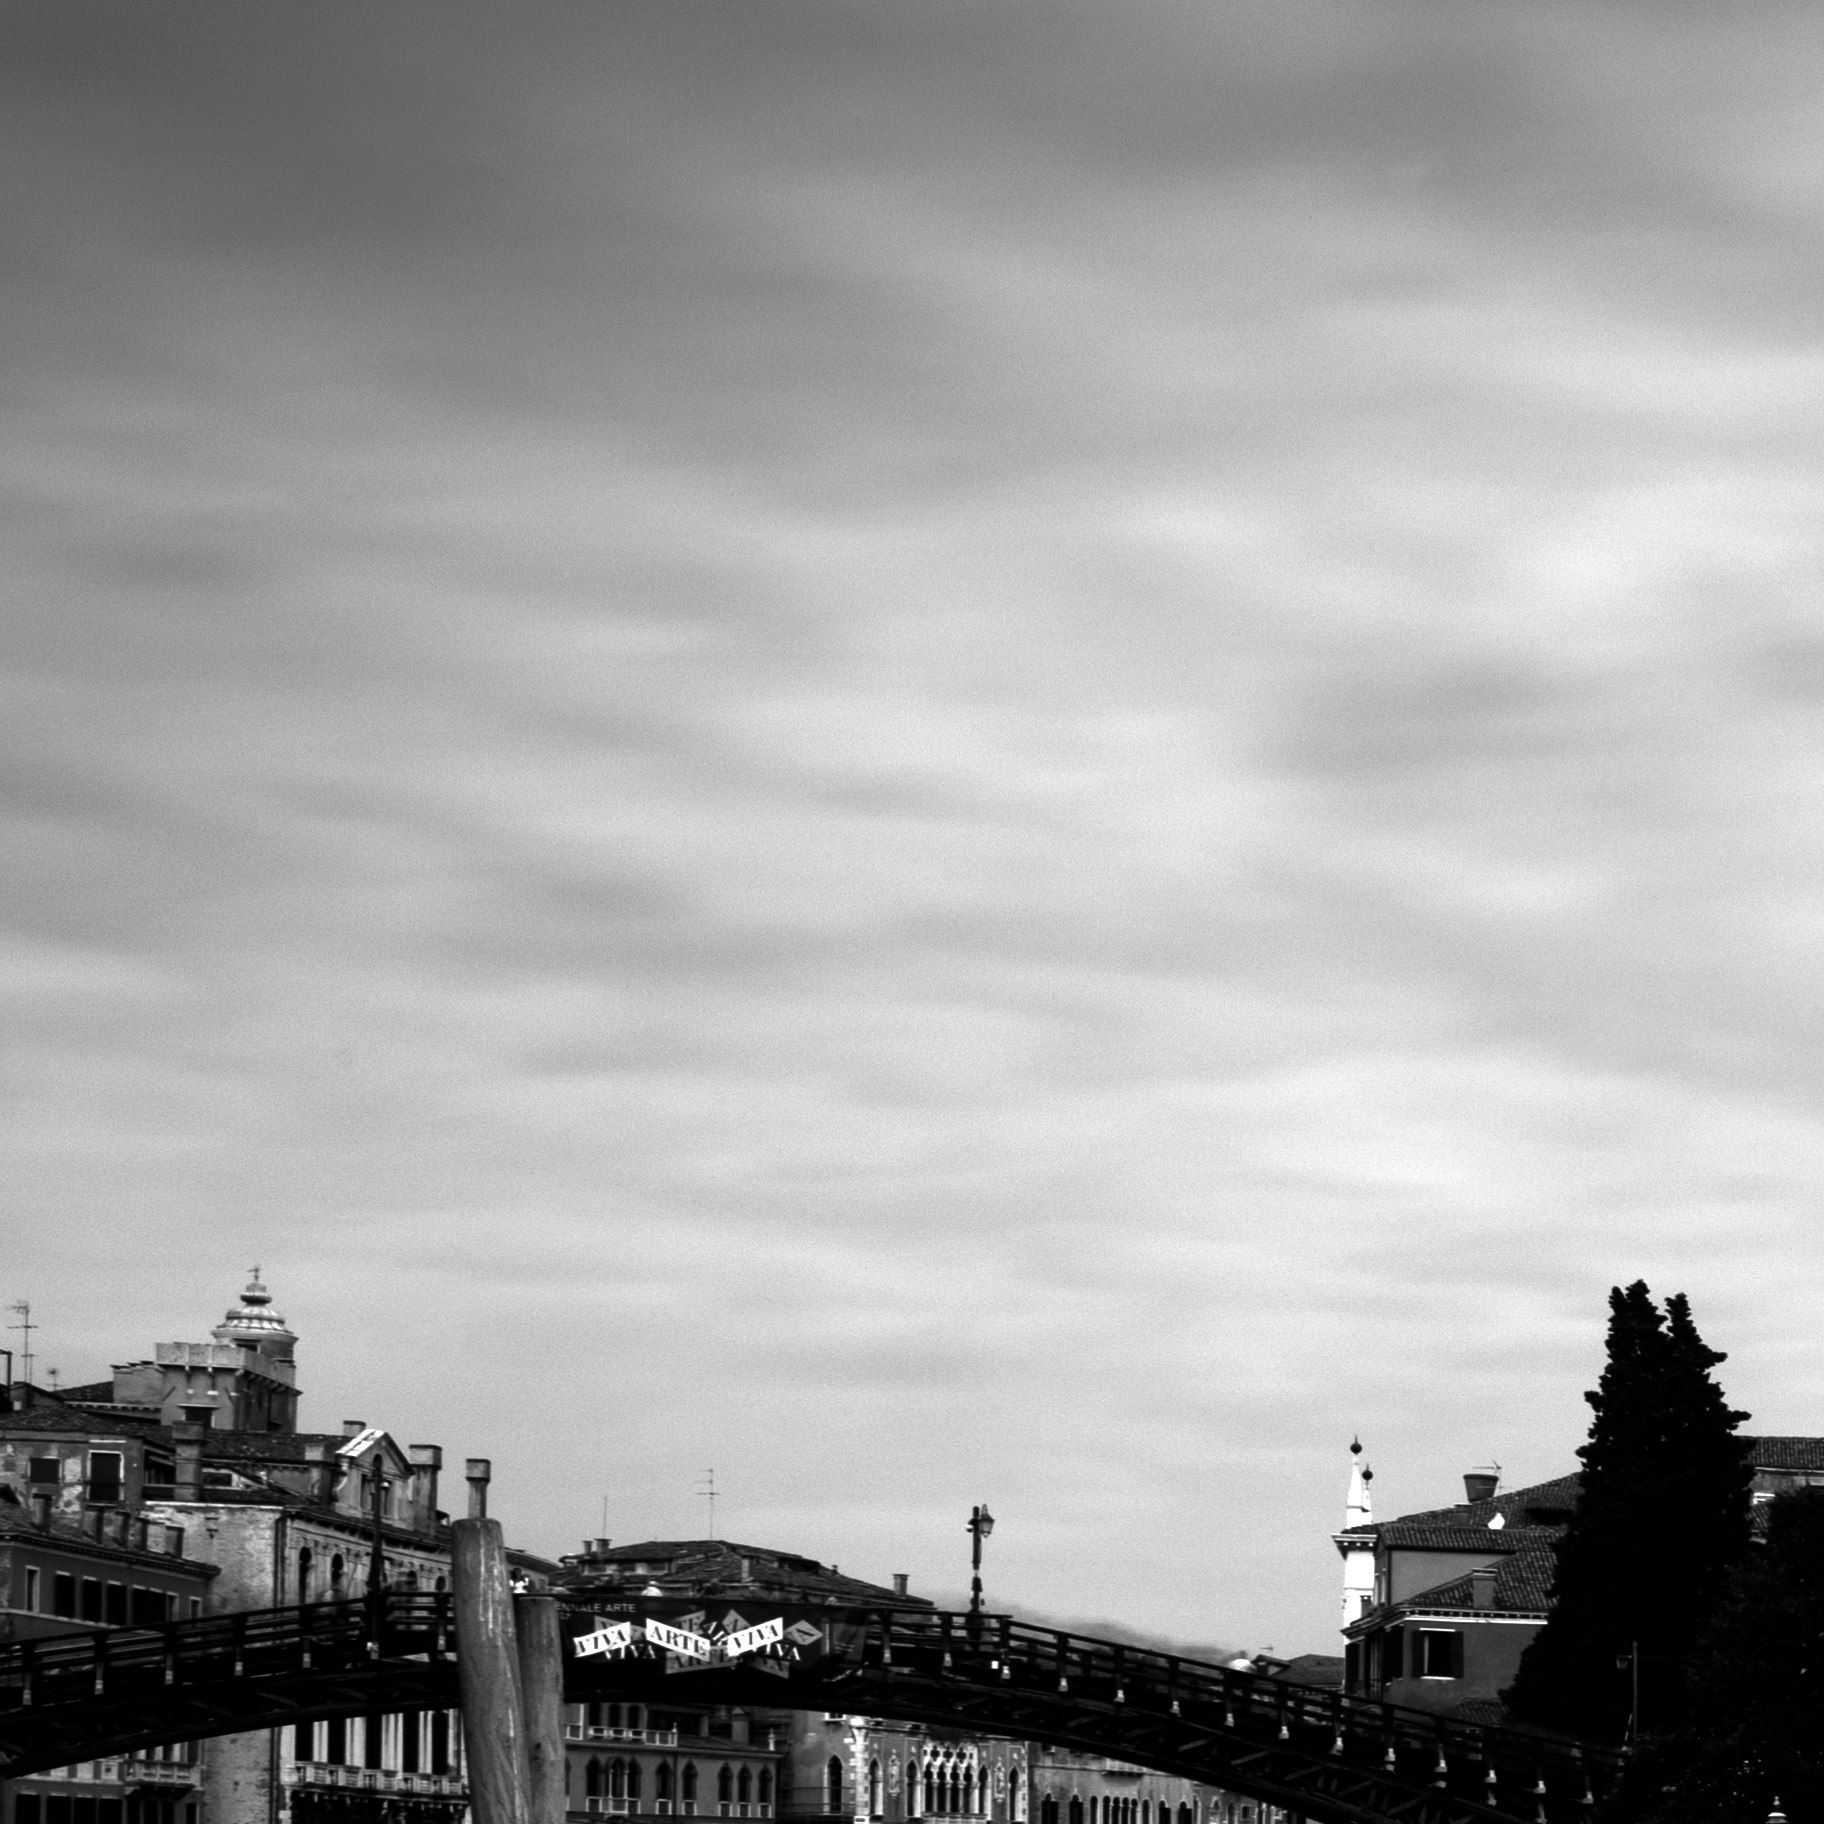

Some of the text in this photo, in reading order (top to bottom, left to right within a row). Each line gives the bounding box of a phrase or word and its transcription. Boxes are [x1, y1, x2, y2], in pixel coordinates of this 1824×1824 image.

[605, 1603, 636, 1613] ARTE
[578, 1629, 626, 1653] VIVA
[650, 1625, 707, 1656] ARTE
[733, 1623, 779, 1649] VIVA
[753, 1642, 802, 1661] IVA
